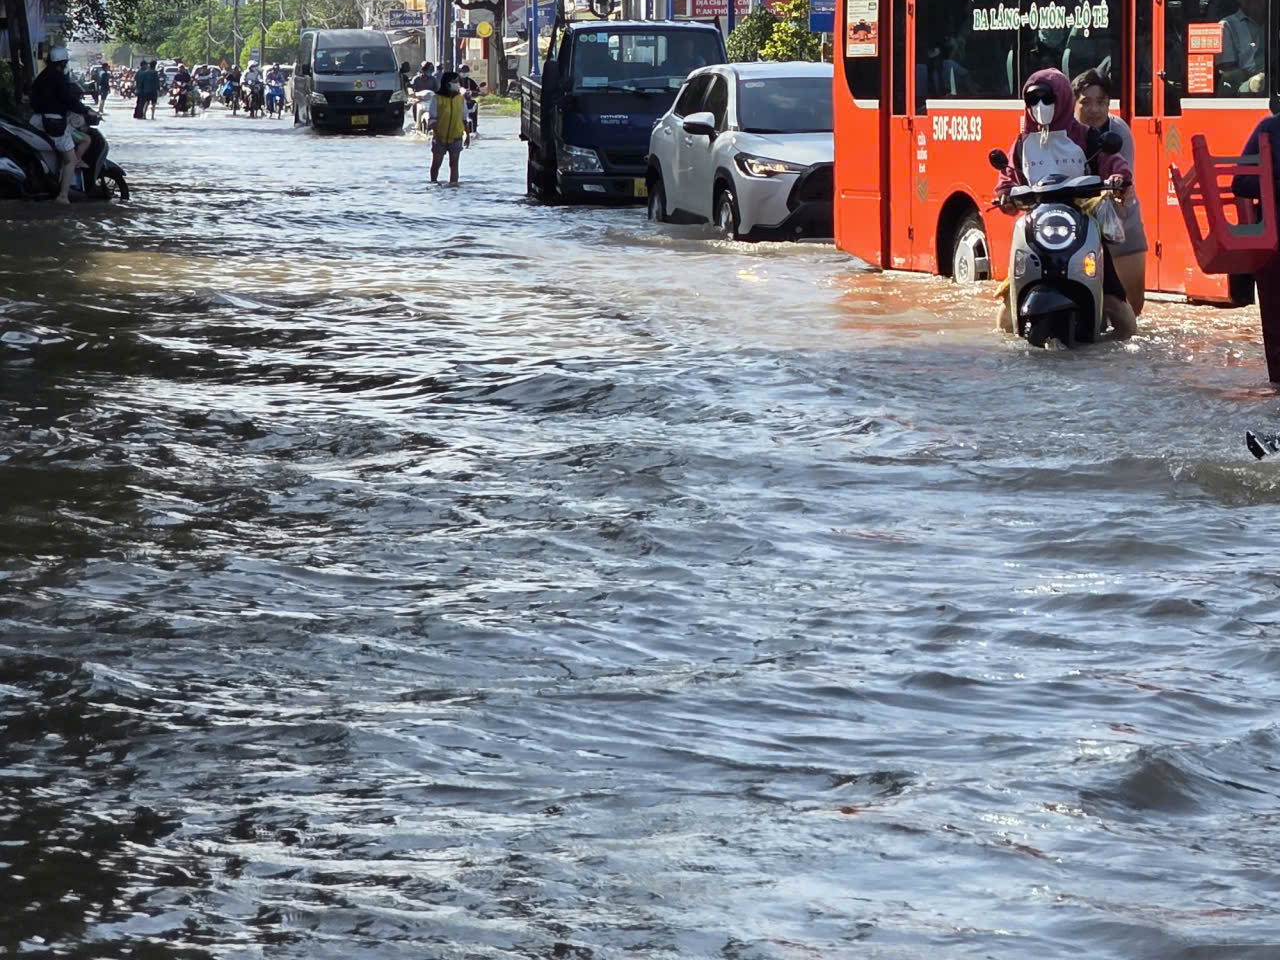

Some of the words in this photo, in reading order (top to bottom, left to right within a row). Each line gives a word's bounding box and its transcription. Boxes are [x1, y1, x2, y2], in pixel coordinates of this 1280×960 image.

[973, 8, 989, 30] BA
[989, 2, 1021, 31] LÁNG
[1028, 1, 1039, 30] Ô
[1039, 1, 1066, 29] MÔN
[1074, 0, 1092, 38] LỘ
[1092, 0, 1109, 29] TẺ
[932, 116, 982, 142] 50F-038.93
